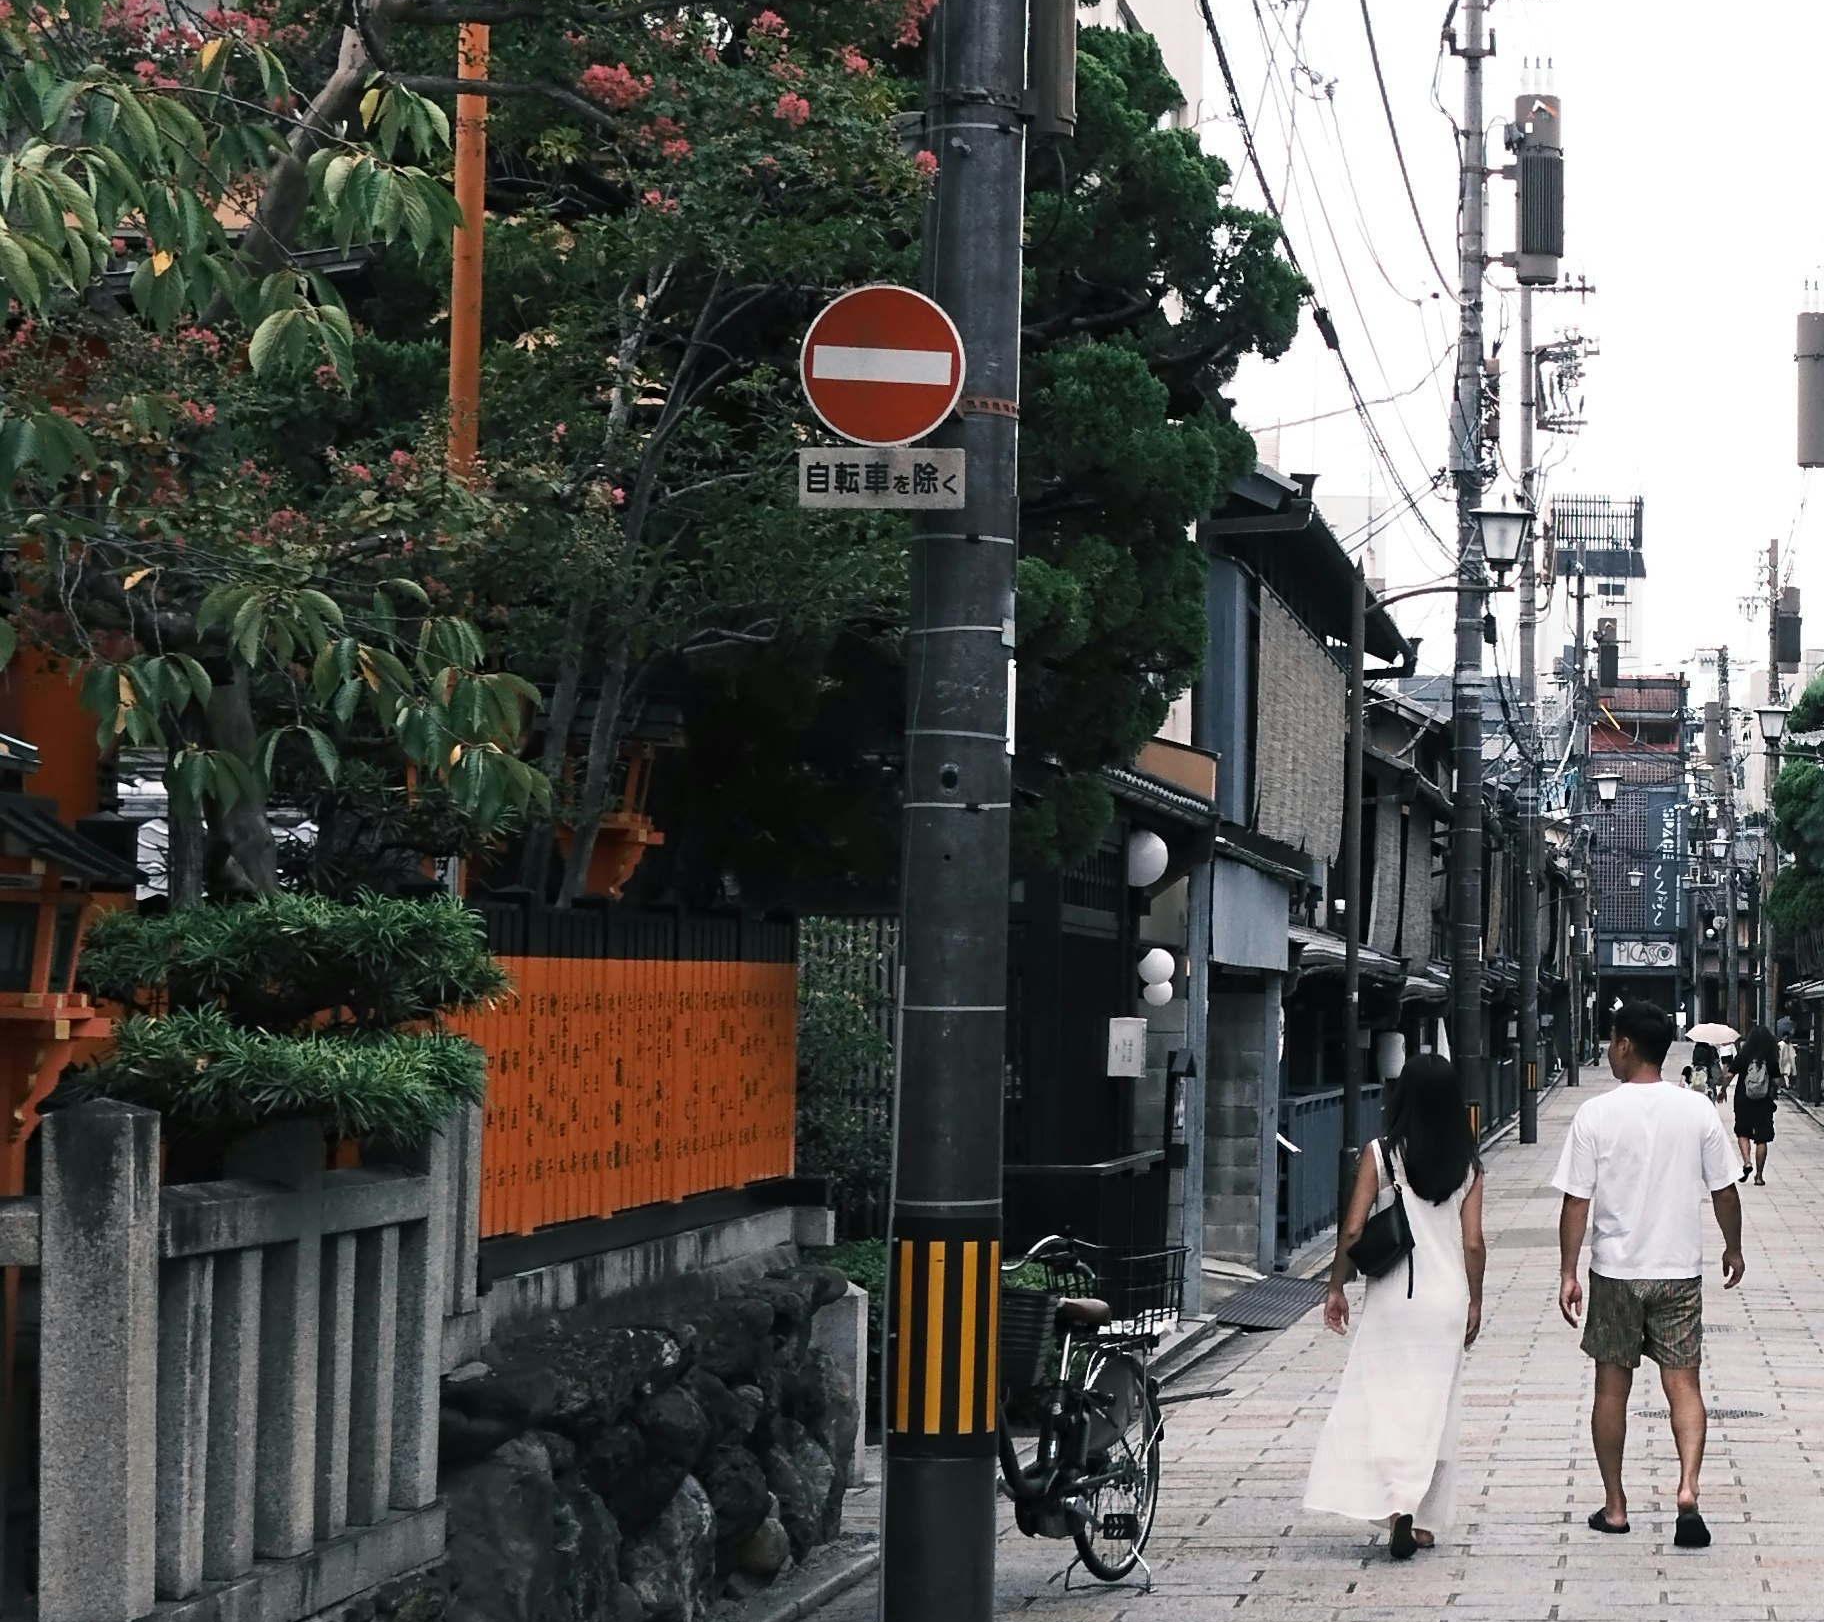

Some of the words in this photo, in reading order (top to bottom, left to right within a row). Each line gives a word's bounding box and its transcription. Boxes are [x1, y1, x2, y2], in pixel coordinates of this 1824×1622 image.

[805, 461, 959, 496] 自転車を除く
[1662, 807, 1675, 860] SPACE
[1616, 942, 1673, 966] PICASSO
